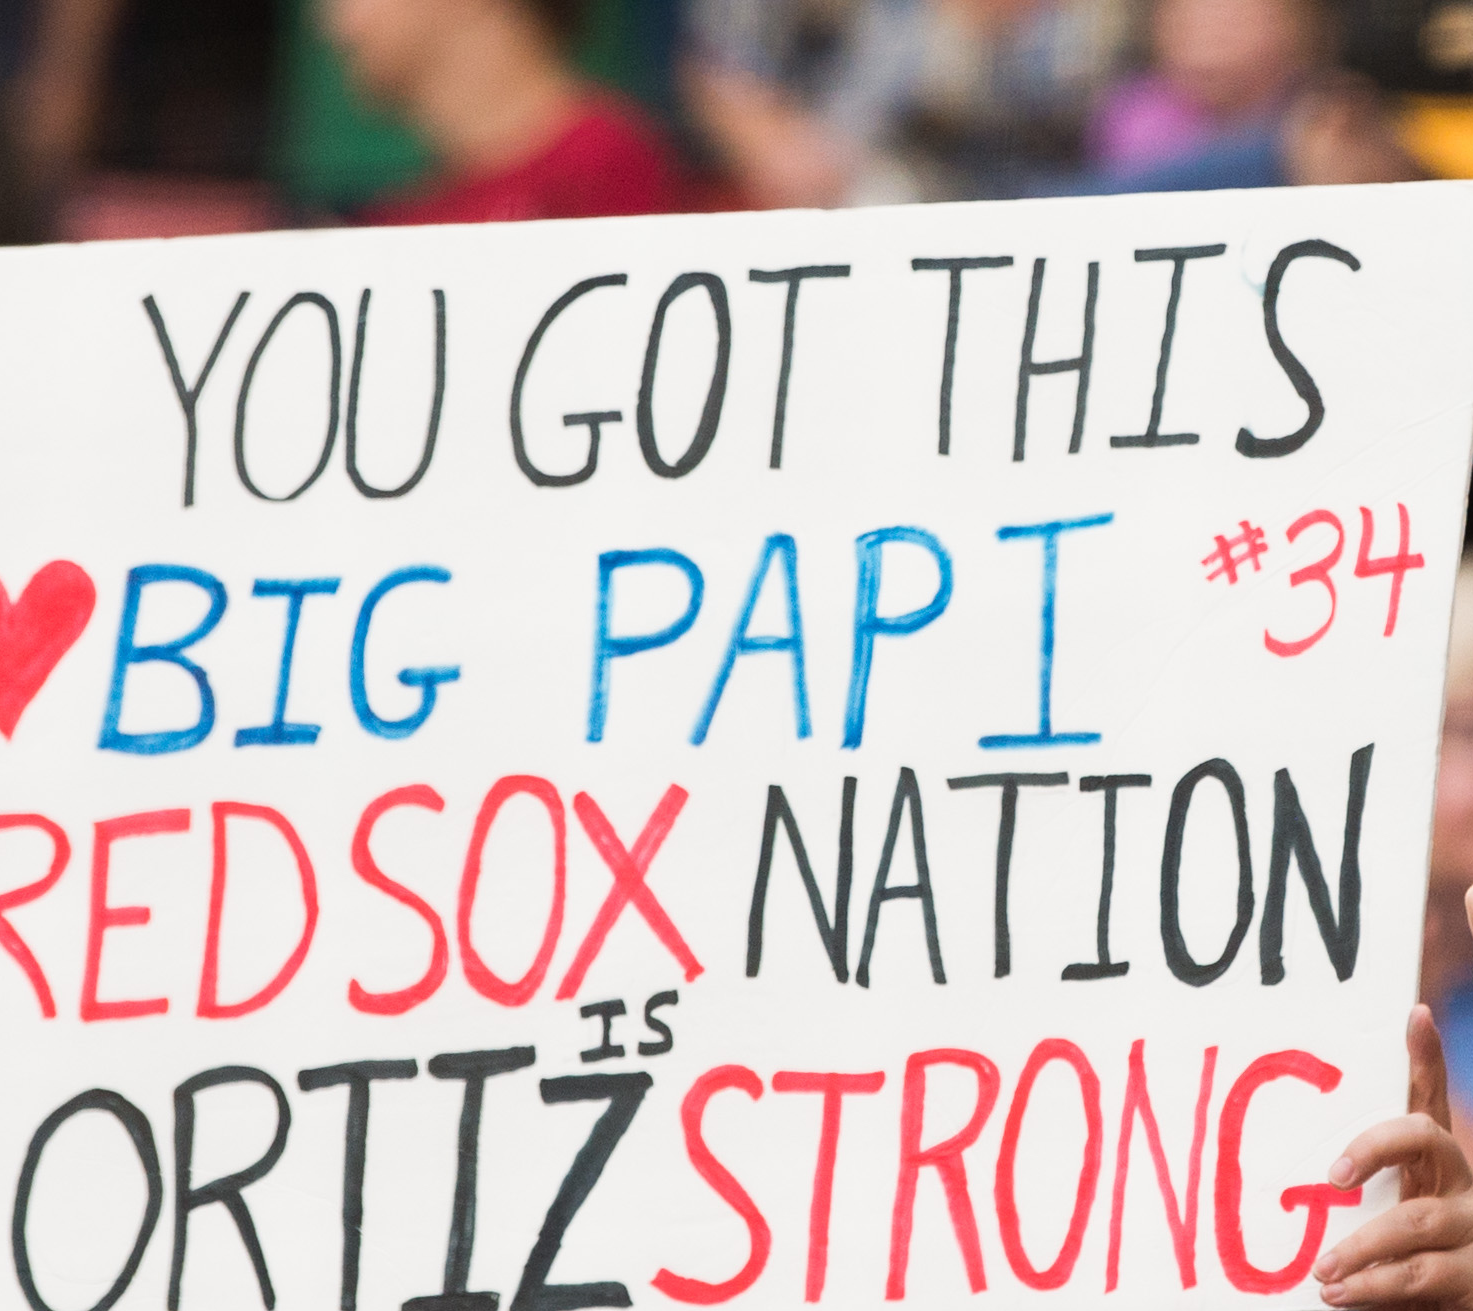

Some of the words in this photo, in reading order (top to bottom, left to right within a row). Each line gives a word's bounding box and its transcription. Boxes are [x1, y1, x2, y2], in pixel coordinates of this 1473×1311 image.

[142, 288, 446, 507] YOU
[511, 264, 850, 488] GOT
[912, 239, 1362, 462] THIS
[99, 563, 462, 756] BIG
[586, 512, 1114, 750] PAPI
[1201, 502, 1426, 659] #34
[746, 743, 1375, 985] NATION
[580, 990, 679, 1063] IS
